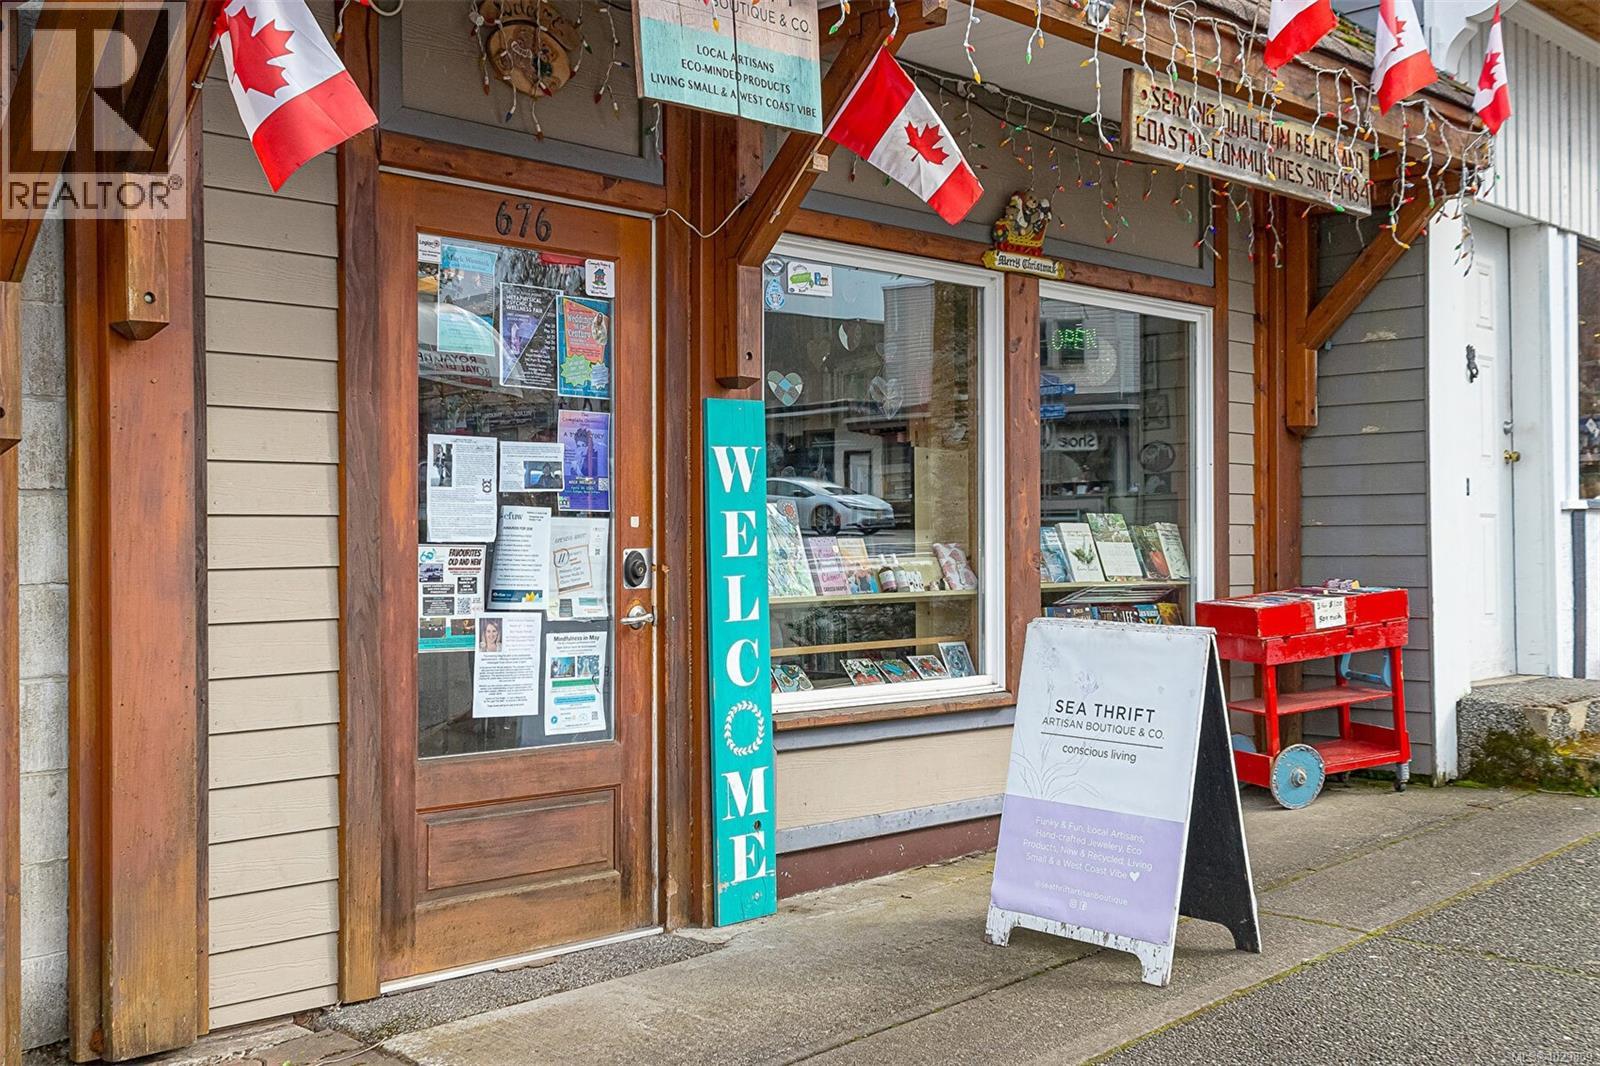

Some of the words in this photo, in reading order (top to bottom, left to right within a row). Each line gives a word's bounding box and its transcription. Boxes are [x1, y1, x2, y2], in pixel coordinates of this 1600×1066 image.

[780, 14, 788, 27] &
[791, 18, 812, 34] CO.
[697, 44, 728, 61] LOCAL
[730, 52, 775, 74] ARTISANS
[681, 58, 742, 82] ECO-MINDED
[744, 75, 791, 94] PRODUCTS
[651, 72, 686, 88] LIVING
[688, 80, 719, 97] SMALL
[721, 87, 728, 97] &
[730, 90, 737, 99] A
[739, 91, 764, 107] WEST
[766, 97, 795, 113] COAST
[797, 105, 817, 119] VIBE
[1136, 115, 1208, 158] COASTAL
[1151, 86, 1215, 125] SERVING
[1295, 133, 1336, 161] BEACH
[495, 201, 552, 242] 676
[998, 254, 1021, 268] Merry
[1022, 257, 1057, 274] Christmas
[448, 548, 482, 557] FAVOURITES
[448, 558, 458, 566] OLD
[459, 558, 470, 566] AND
[470, 558, 482, 566] NEW
[1054, 699, 1087, 716] SEA
[1094, 703, 1155, 723] THRIFT
[1041, 717, 1083, 730] ARTISAN
[1086, 721, 1136, 737] BOUTIQUE
[1138, 729, 1145, 737] &
[1148, 730, 1165, 740] CO.
[1062, 744, 1109, 759] conscious
[1110, 749, 1137, 764] living
[1036, 816, 1060, 829] Funky
[1061, 820, 1067, 829] &
[1087, 825, 1109, 836] Local
[1035, 829, 1086, 845] Hand-crafted
[1126, 844, 1142, 855] Eco
[1026, 852, 1047, 864] Small
[1048, 857, 1054, 865] &
[1063, 859, 1083, 871] West
[1084, 863, 1107, 876] Coast
[1109, 868, 1127, 879] Vibe
[1060, 846, 1079, 856] New
[1080, 849, 1086, 858] &
[1127, 858, 1153, 872] Living
